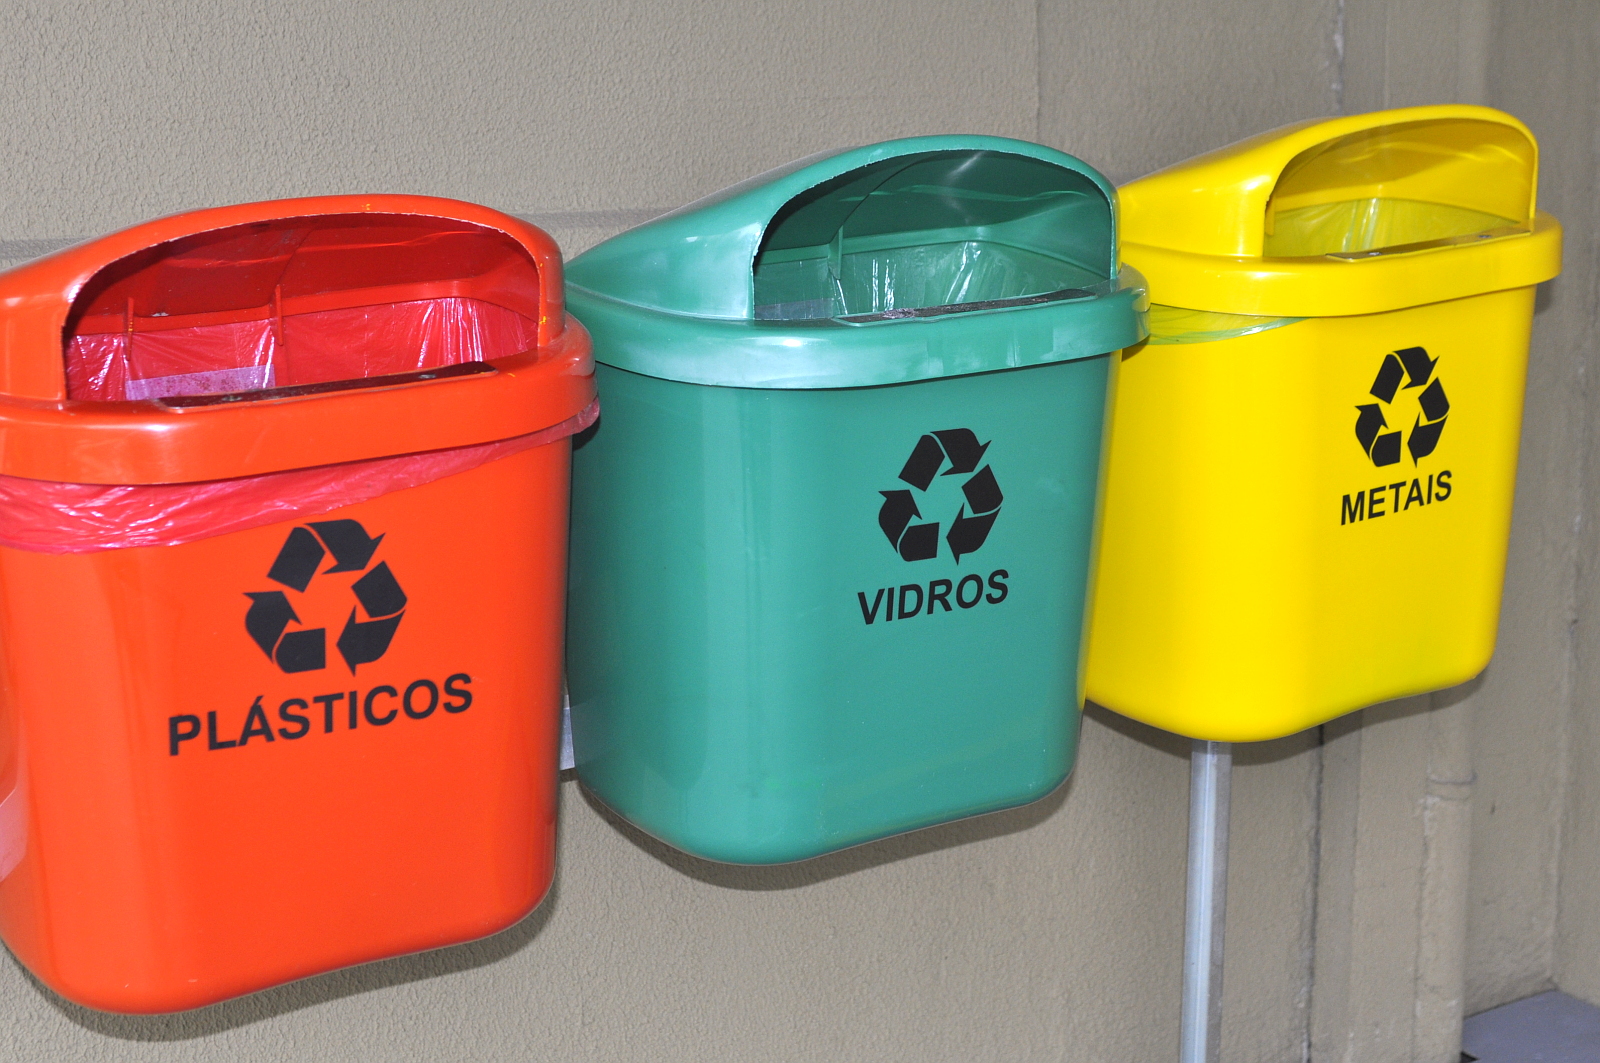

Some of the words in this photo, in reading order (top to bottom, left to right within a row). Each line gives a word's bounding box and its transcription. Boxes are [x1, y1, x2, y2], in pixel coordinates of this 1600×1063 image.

[1341, 469, 1452, 526] METAIS
[857, 568, 1010, 626] VIDROS
[169, 673, 473, 756] PLÁSTICOS
